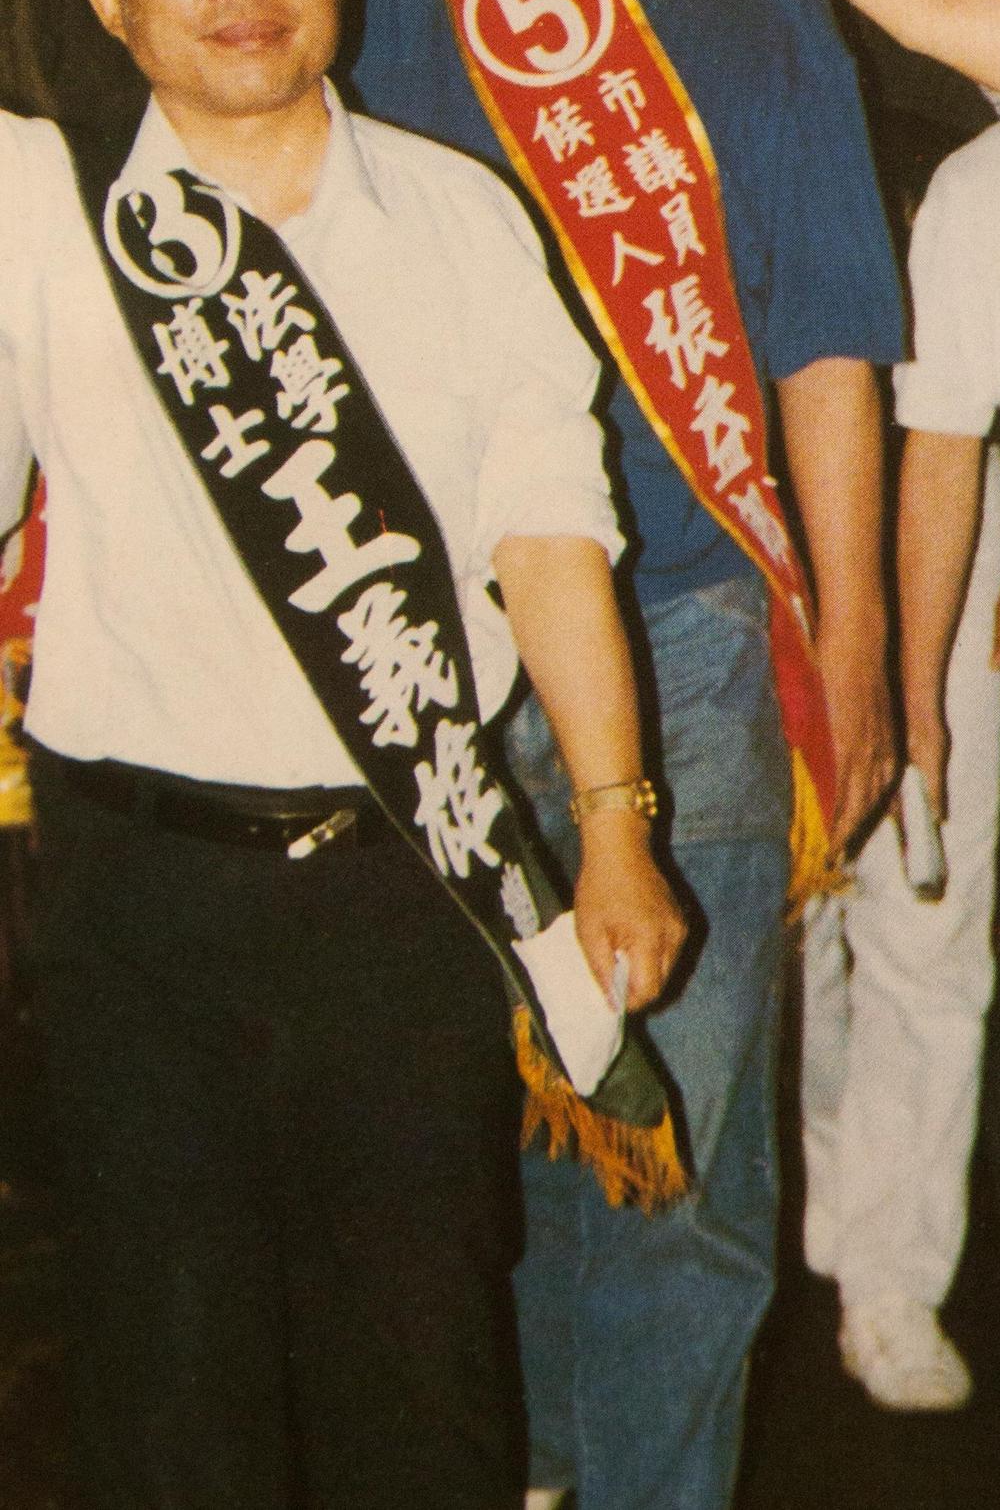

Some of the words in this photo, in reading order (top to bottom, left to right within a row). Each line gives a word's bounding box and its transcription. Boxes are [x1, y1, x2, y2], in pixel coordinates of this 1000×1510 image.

[124, 168, 226, 288] 3
[531, 96, 665, 287] 候選人
[598, 68, 706, 266] 市議員
[152, 297, 271, 479] 博士
[220, 270, 350, 433] 法學
